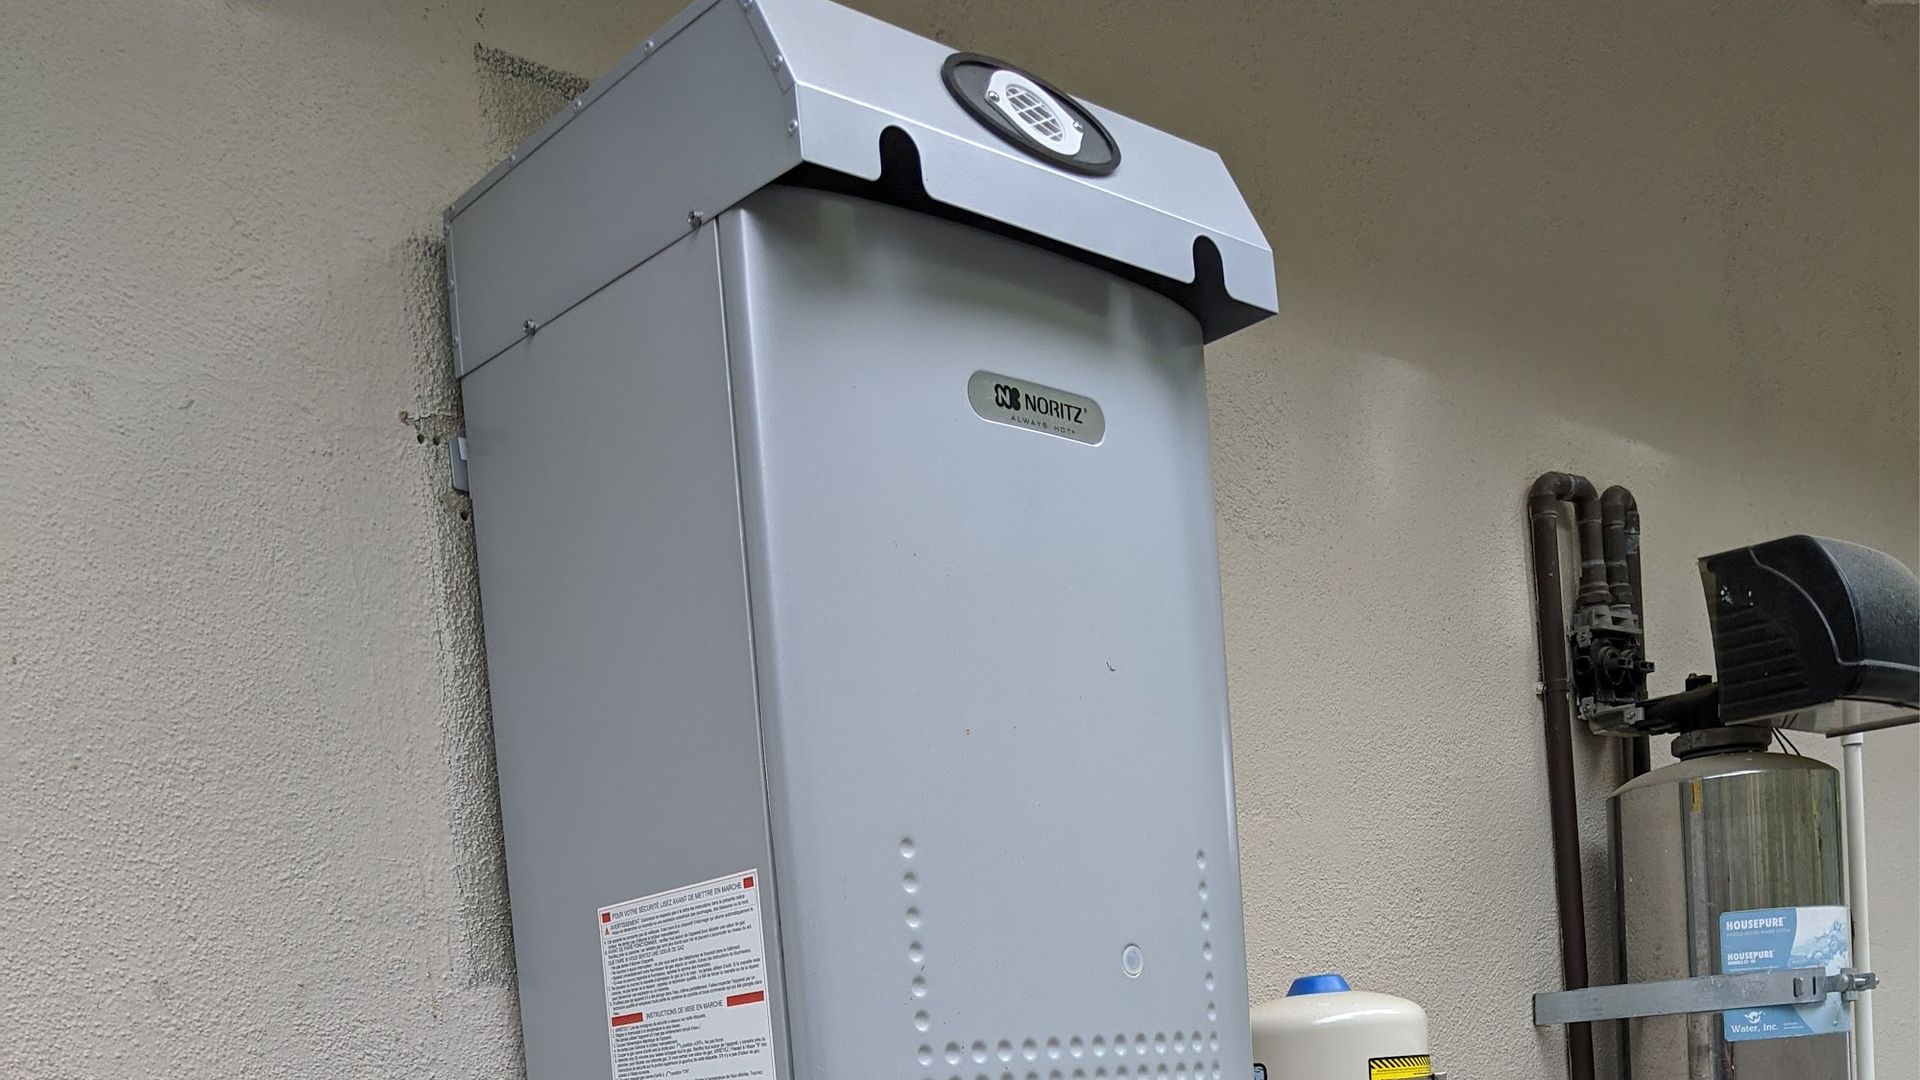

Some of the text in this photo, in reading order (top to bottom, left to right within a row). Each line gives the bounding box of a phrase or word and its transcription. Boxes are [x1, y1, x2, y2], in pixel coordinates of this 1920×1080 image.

[1025, 393, 1083, 424] NORITZ
[1011, 415, 1048, 429] ALWAYS
[612, 910, 624, 920] POUR
[624, 907, 638, 918] VOTRE
[660, 899, 672, 909] LISEZ
[672, 895, 687, 905] AVANT
[688, 893, 695, 902] DE
[694, 888, 714, 900] METTRE
[714, 886, 721, 895] EN
[721, 881, 742, 893] MARCHE
[1726, 917, 1784, 931] HOUSEPURE
[1727, 950, 1774, 961] HOUSEPURE
[646, 1009, 677, 1020] INSTRUCTIONS
[678, 1006, 684, 1014] DE
[684, 1003, 696, 1013] MISE
[703, 999, 723, 1009] MARCHE
[1731, 1024, 1761, 1033] Water,
[1763, 1023, 1780, 1031] Inc.
